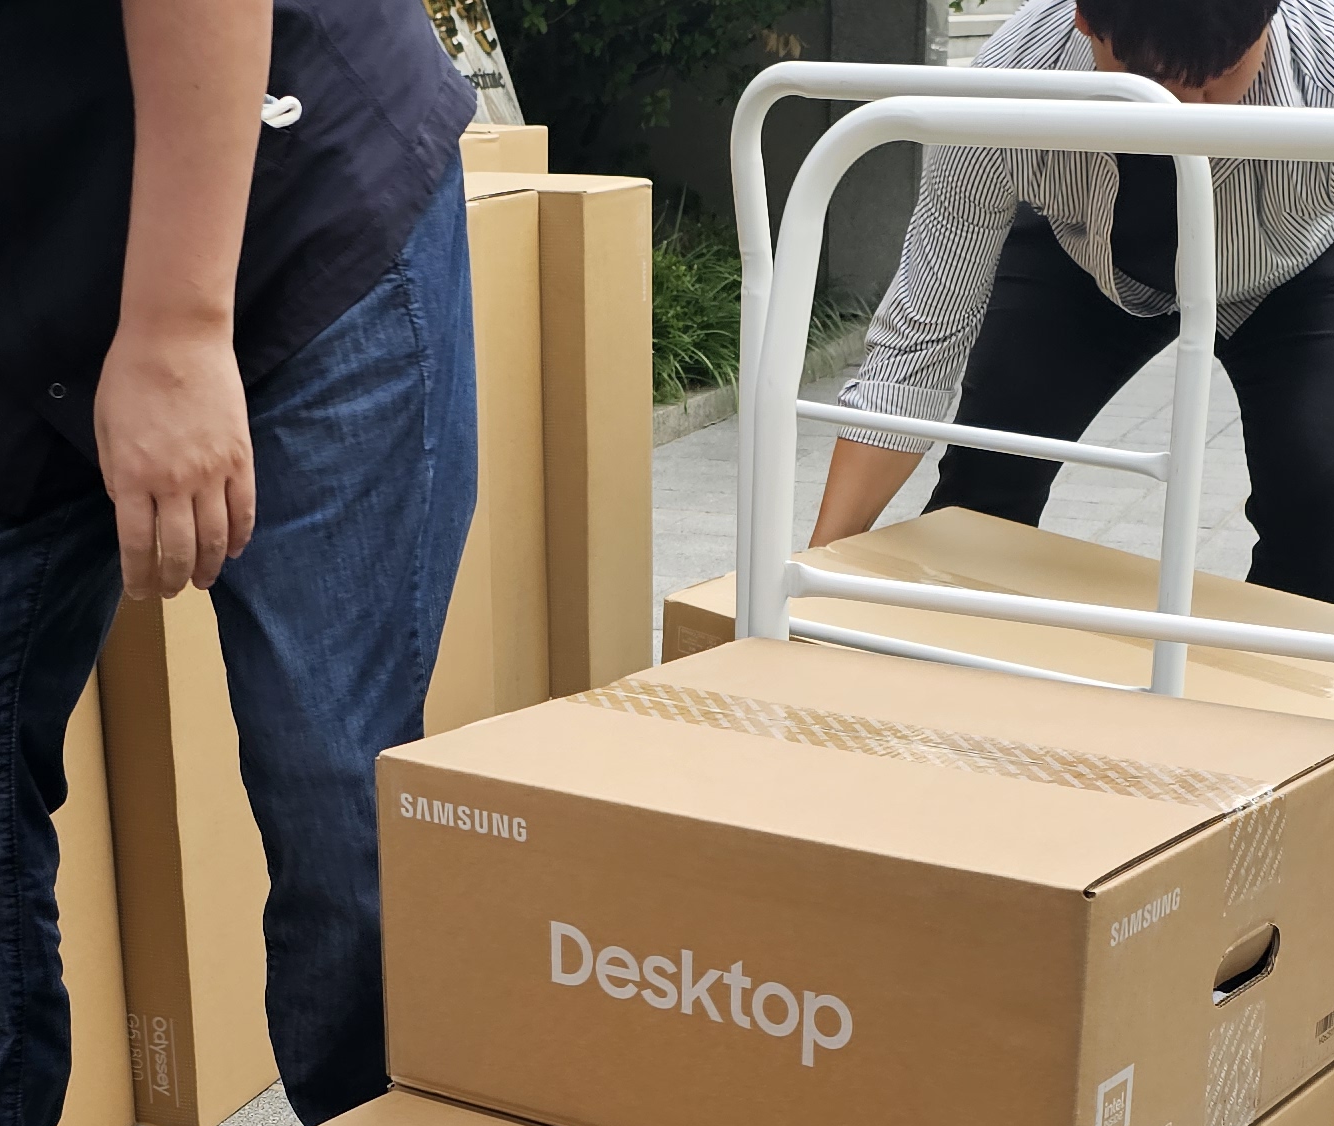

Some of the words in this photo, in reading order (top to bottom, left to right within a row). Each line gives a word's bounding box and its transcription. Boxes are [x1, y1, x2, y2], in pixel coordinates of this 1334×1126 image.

[400, 791, 527, 842] SAMSUNG
[1110, 887, 1181, 947] SAMSUNG
[551, 921, 852, 1067] Desktop
[149, 1016, 170, 1096] Odyssey
[1104, 1091, 1125, 1119] intel
